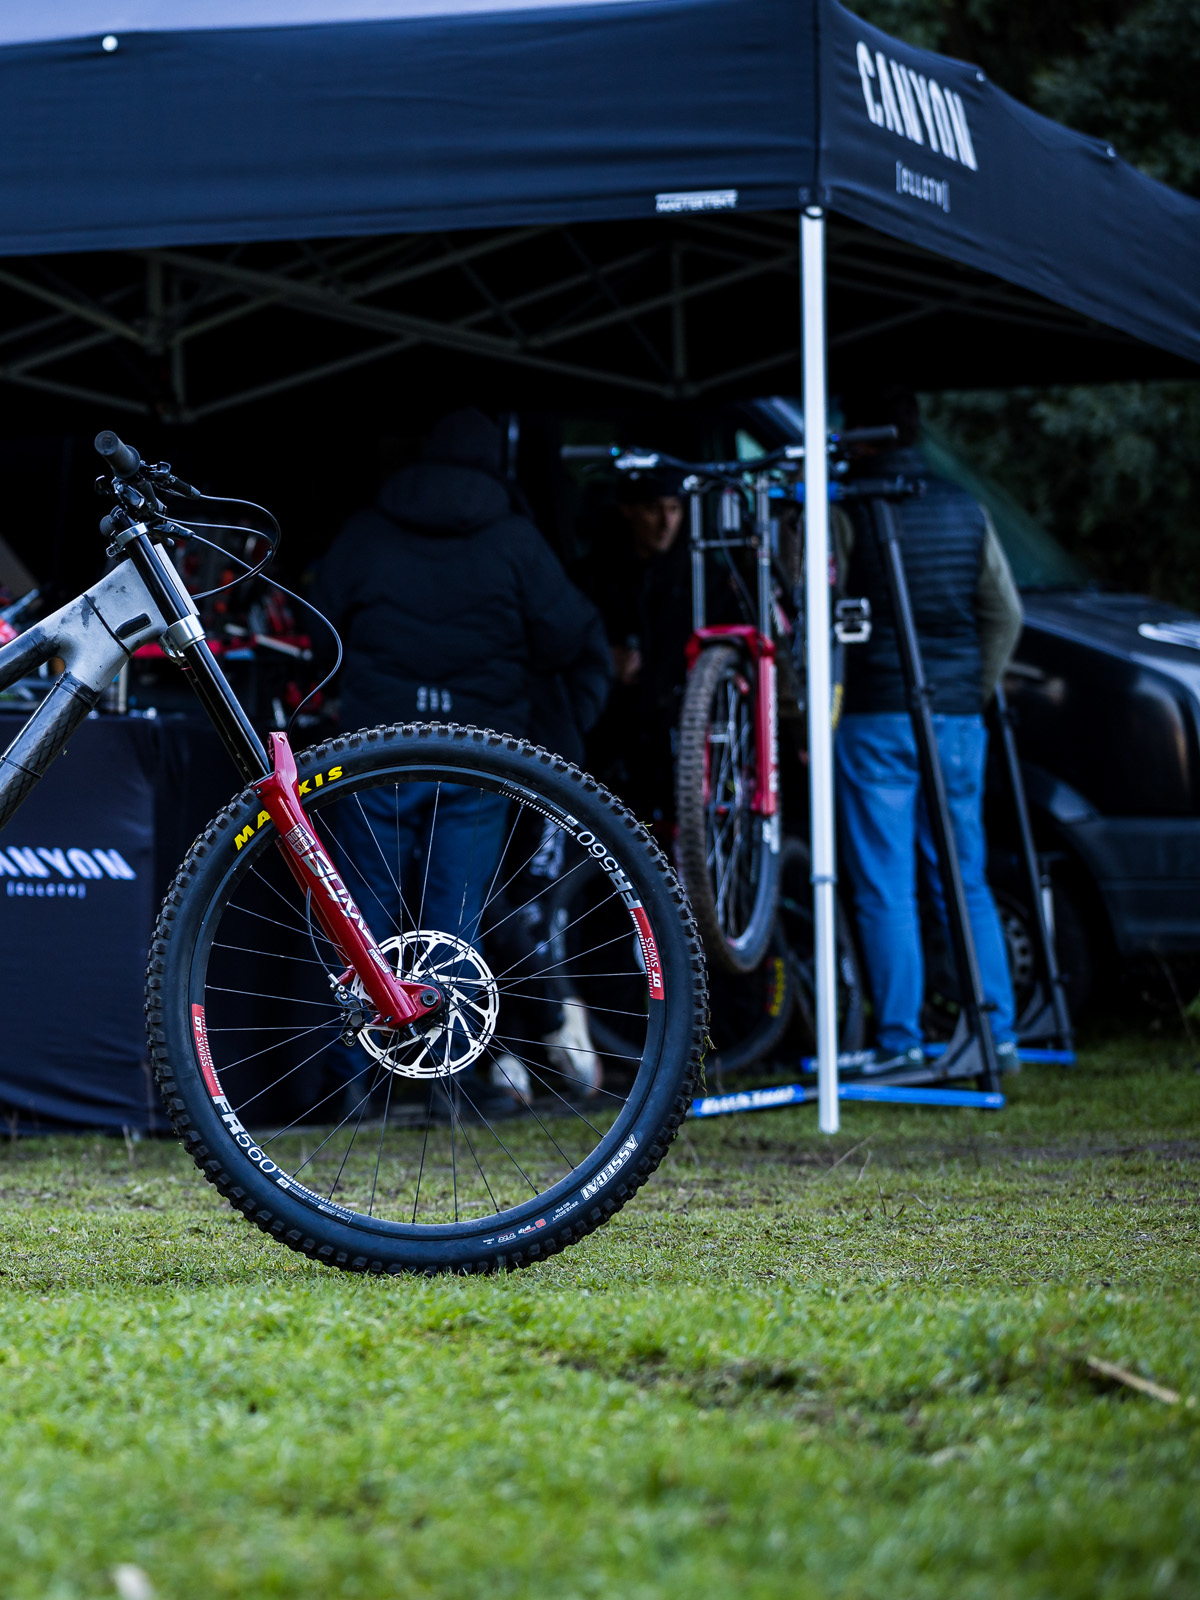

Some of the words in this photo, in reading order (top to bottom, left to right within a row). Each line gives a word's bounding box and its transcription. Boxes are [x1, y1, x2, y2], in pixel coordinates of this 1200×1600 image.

[856, 40, 979, 171] CANYON
[234, 766, 343, 851] MAXIS
[576, 831, 643, 910] FR560
[645, 937, 659, 968] SWISS
[651, 970, 662, 988] DT
[194, 1015, 203, 1034] DT
[196, 1036, 210, 1067] SWISS
[211, 1095, 278, 1173] FR560
[580, 1133, 639, 1201] ASSEGAI
